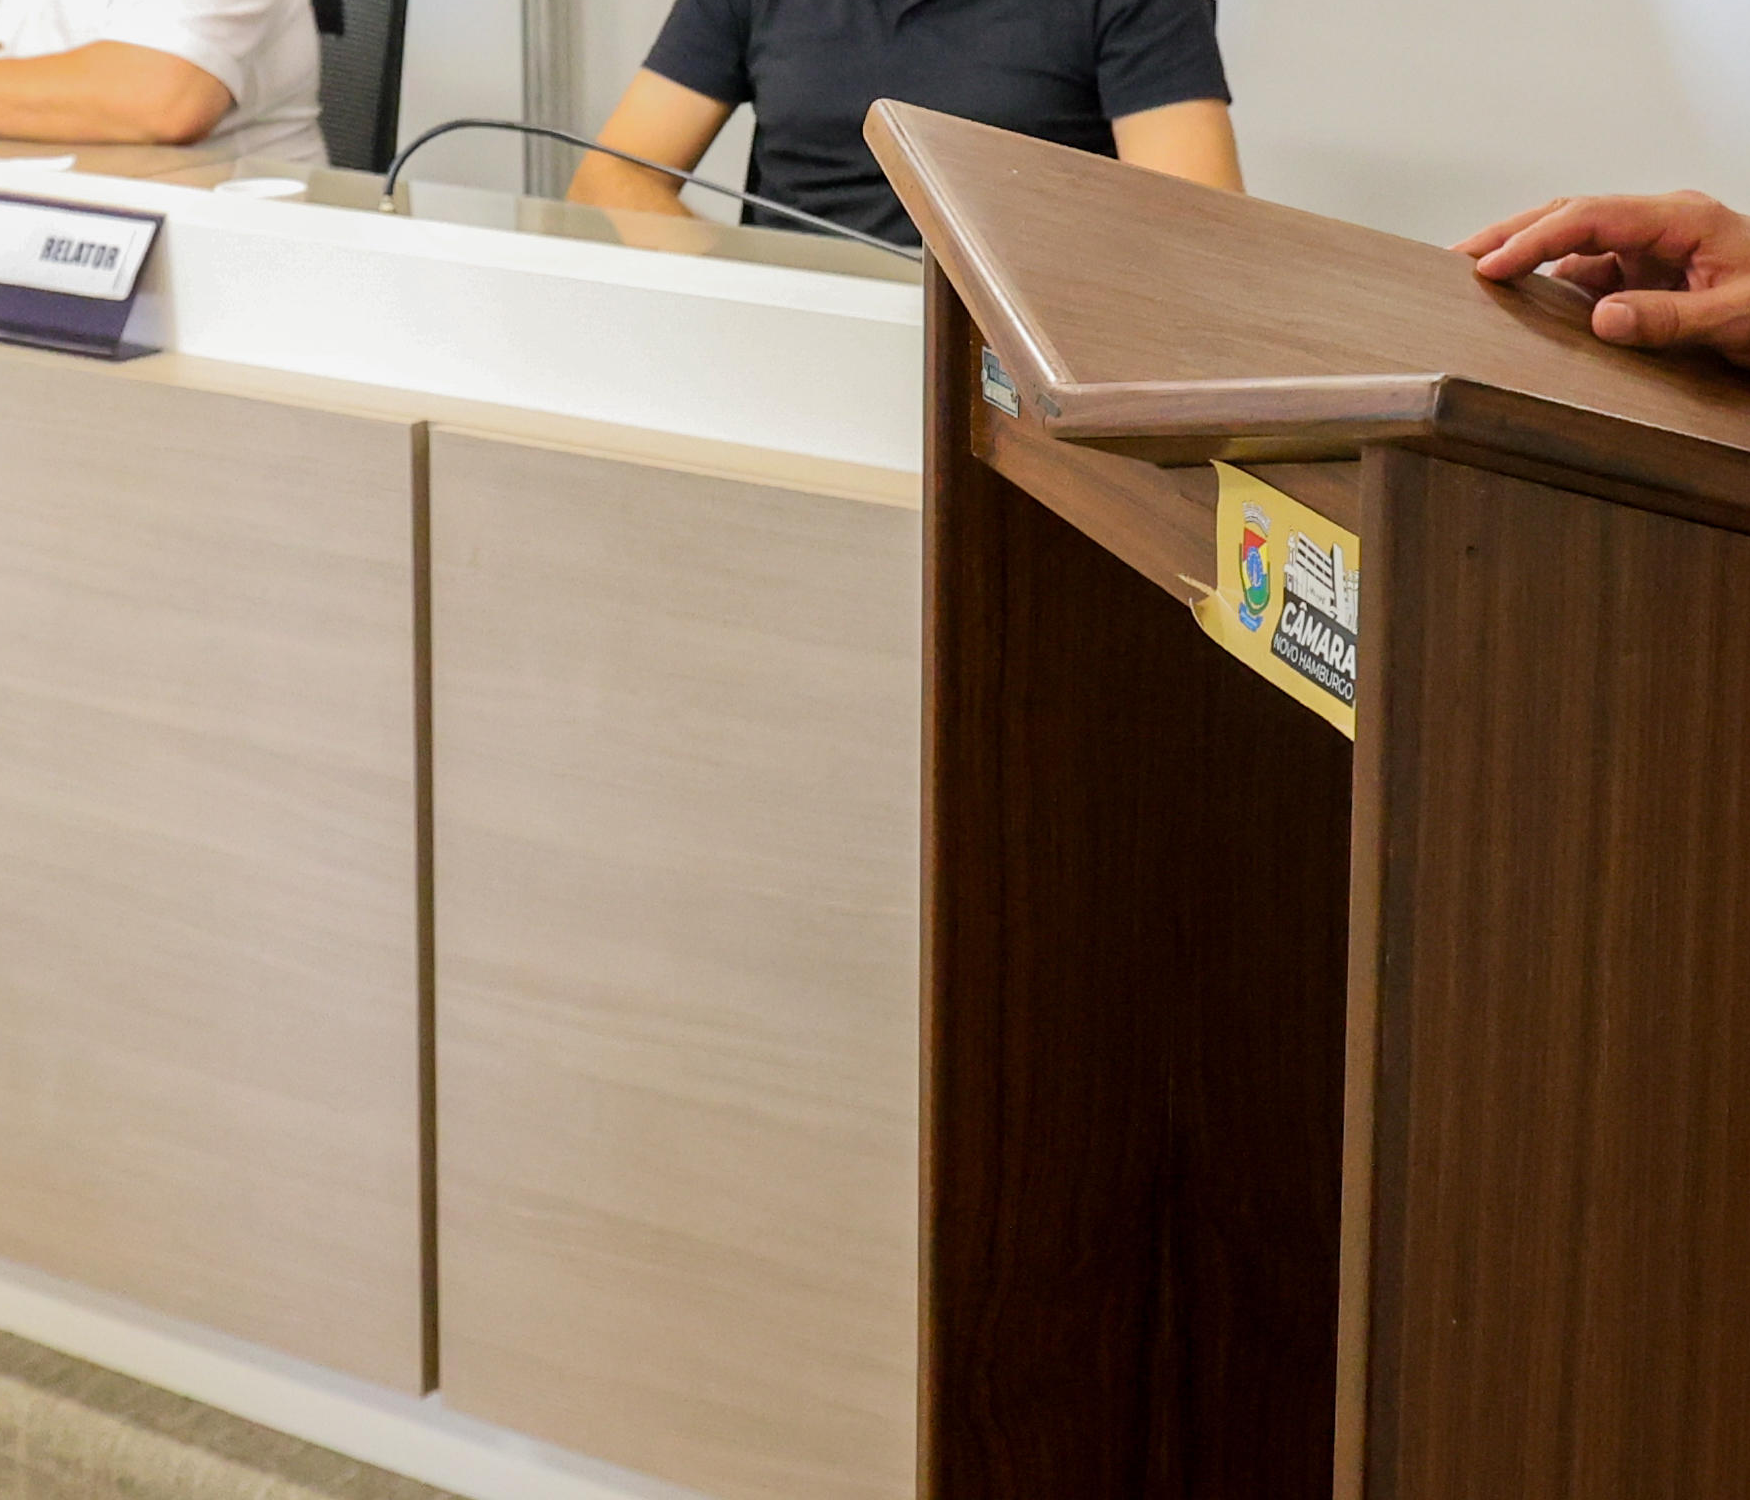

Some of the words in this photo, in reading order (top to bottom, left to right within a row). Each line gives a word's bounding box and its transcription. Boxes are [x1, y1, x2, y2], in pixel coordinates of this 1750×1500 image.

[40, 236, 121, 271] RELATOR
[1273, 633, 1298, 663] NOVO
[1298, 650, 1354, 700] HAMBURGO
[1281, 601, 1356, 680] CÂMARA
